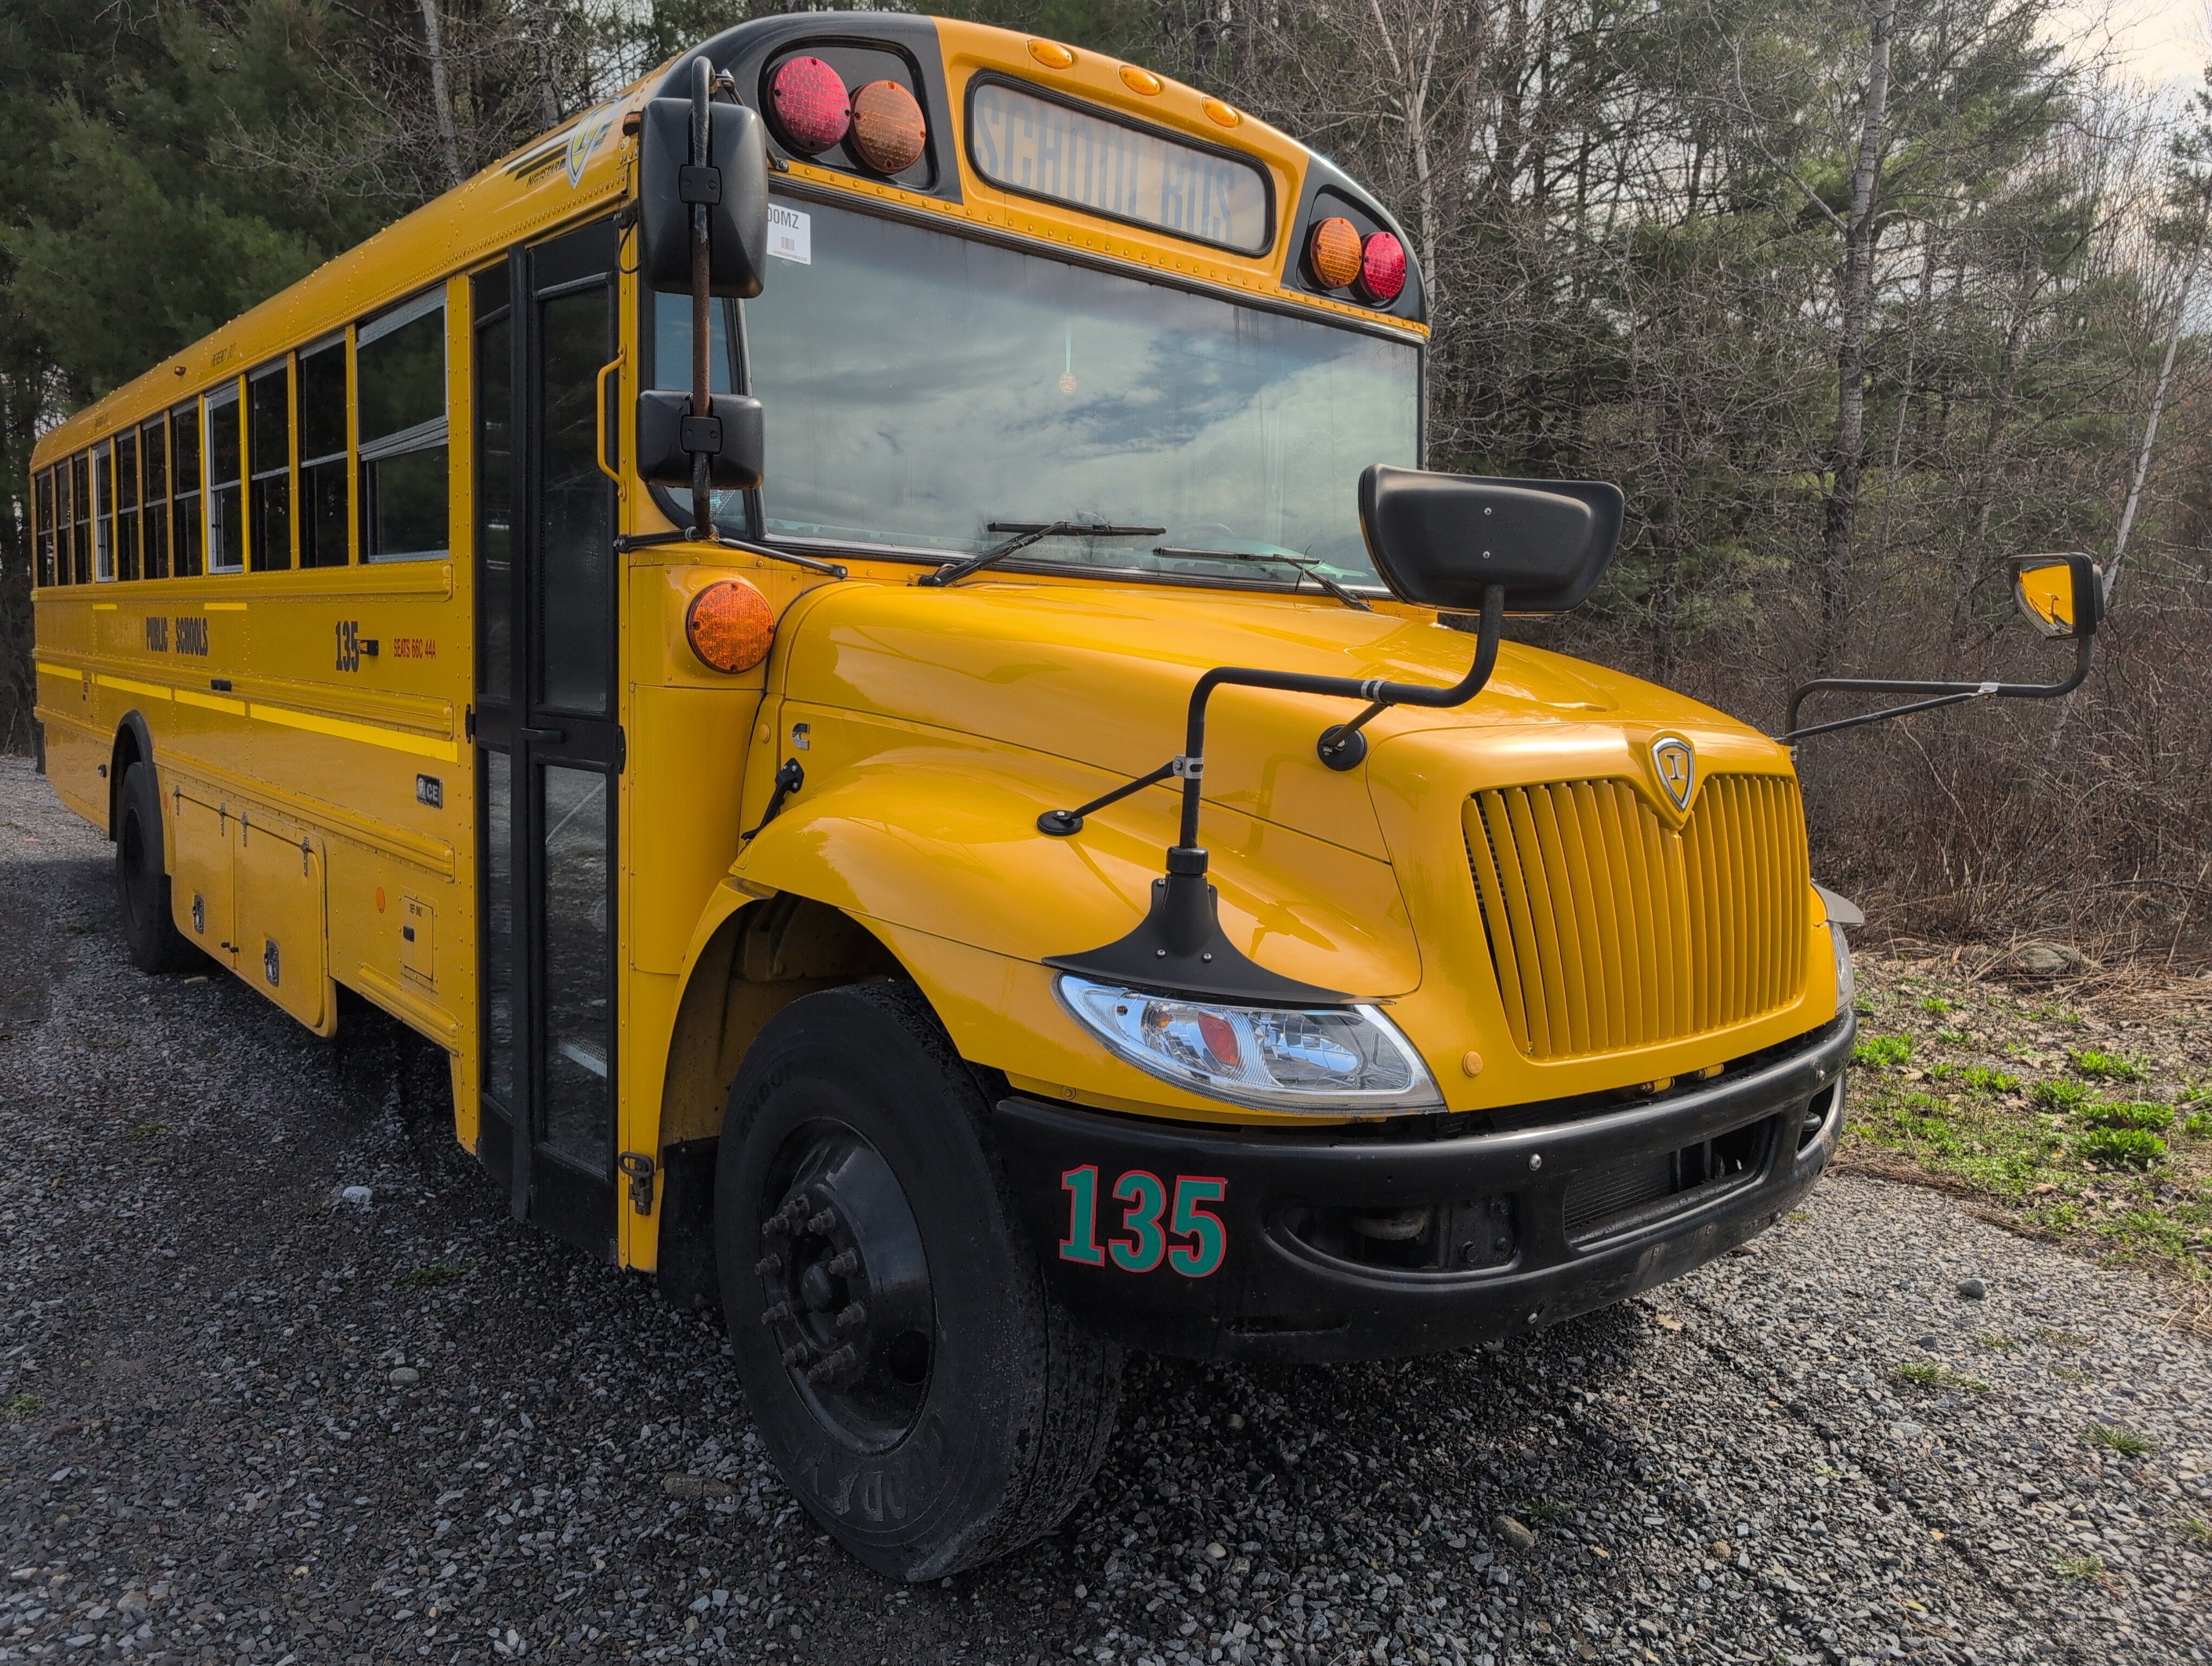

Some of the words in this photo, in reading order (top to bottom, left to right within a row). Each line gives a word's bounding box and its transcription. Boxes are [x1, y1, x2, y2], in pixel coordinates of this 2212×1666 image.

[974, 88, 1148, 221] SCHOOL
[1160, 149, 1236, 245] BUS
[146, 616, 168, 652] PUBLIC
[175, 616, 208, 657] SCHOOLS
[336, 620, 359, 672] 135
[394, 638, 410, 658] SEATS
[411, 638, 423, 659] 66C
[425, 638, 436, 659] 44A
[1059, 1164, 1227, 1278] 135
